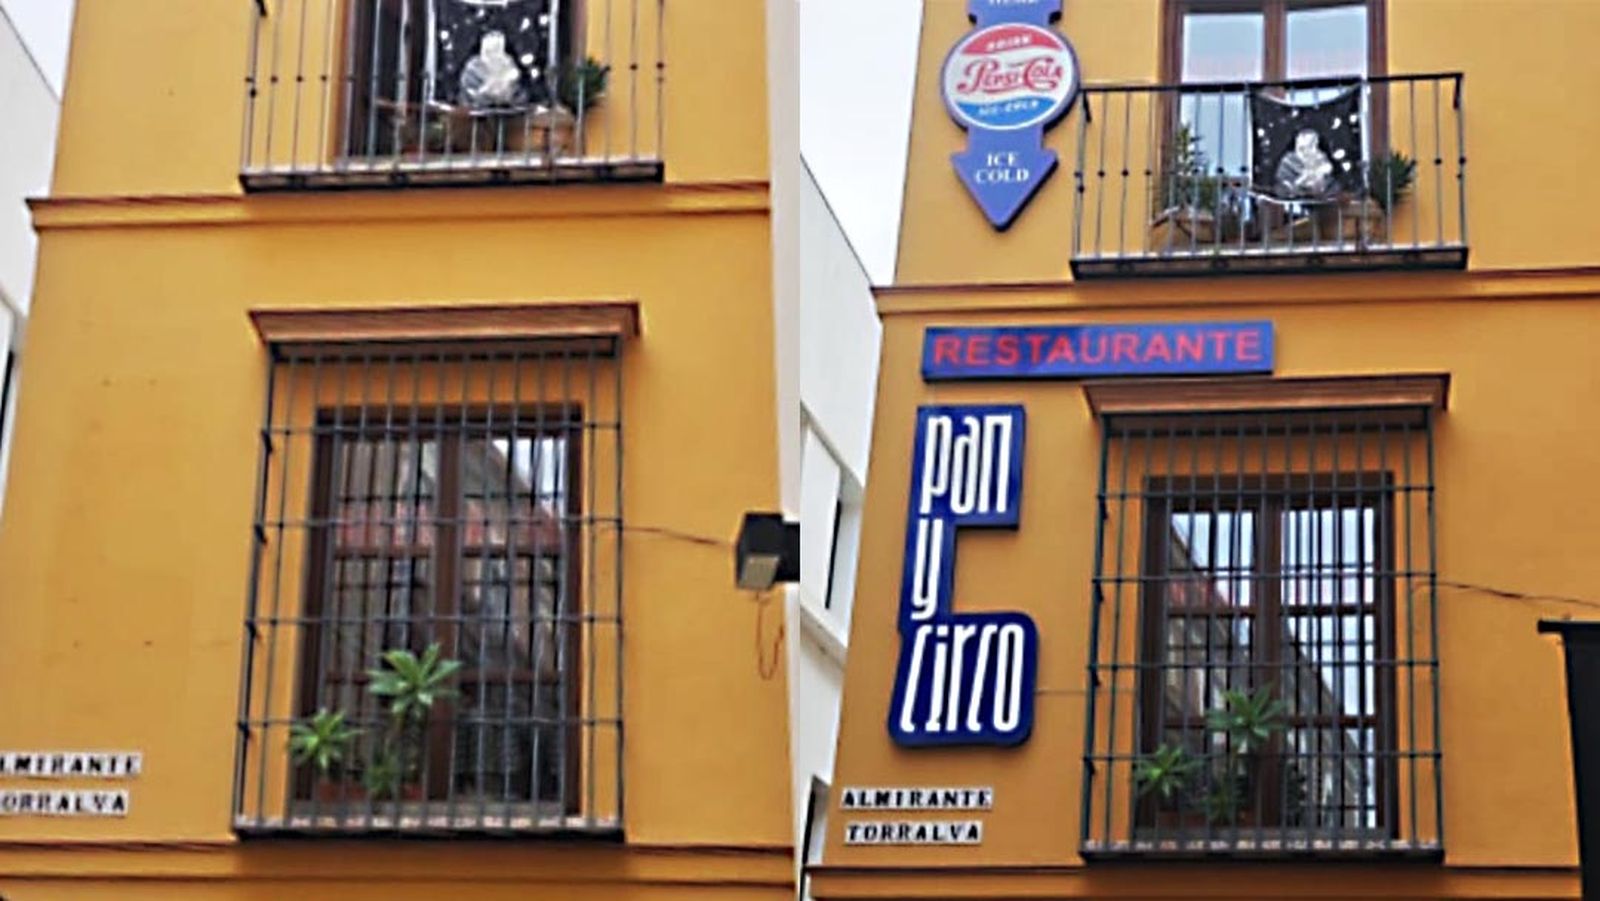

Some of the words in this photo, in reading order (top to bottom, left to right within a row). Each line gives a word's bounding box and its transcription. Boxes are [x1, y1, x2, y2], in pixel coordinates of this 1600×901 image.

[986, 152, 1018, 167] ICE
[975, 168, 1030, 184] COLD
[932, 330, 1263, 367] RESTAURANTE
[842, 789, 992, 807] ALMIRANTE
[847, 823, 980, 841] TORRALVA
